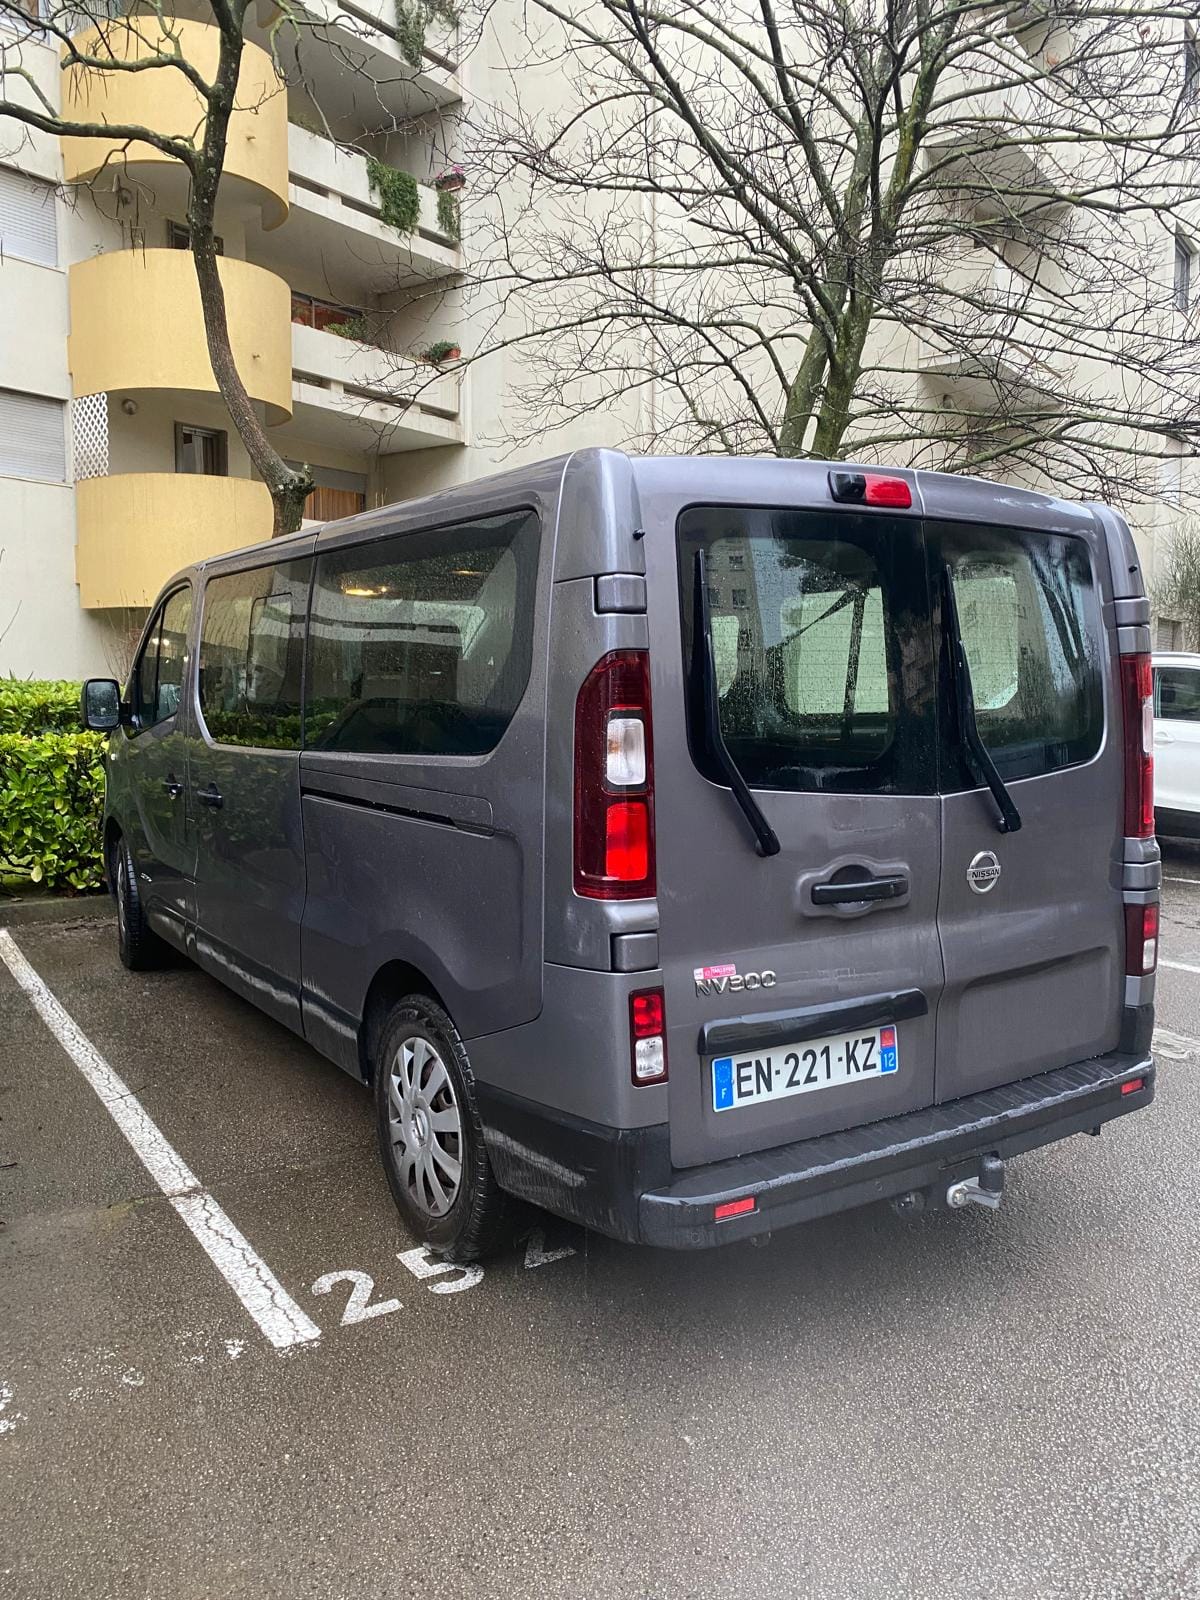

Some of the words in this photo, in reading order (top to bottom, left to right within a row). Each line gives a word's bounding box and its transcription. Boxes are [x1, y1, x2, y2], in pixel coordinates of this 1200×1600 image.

[971, 868, 1000, 878] NISSAN
[695, 970, 777, 998] NV300
[736, 1036, 877, 1099] EN-221-KZ
[884, 1052, 895, 1068] 12
[721, 1087, 727, 1100] F
